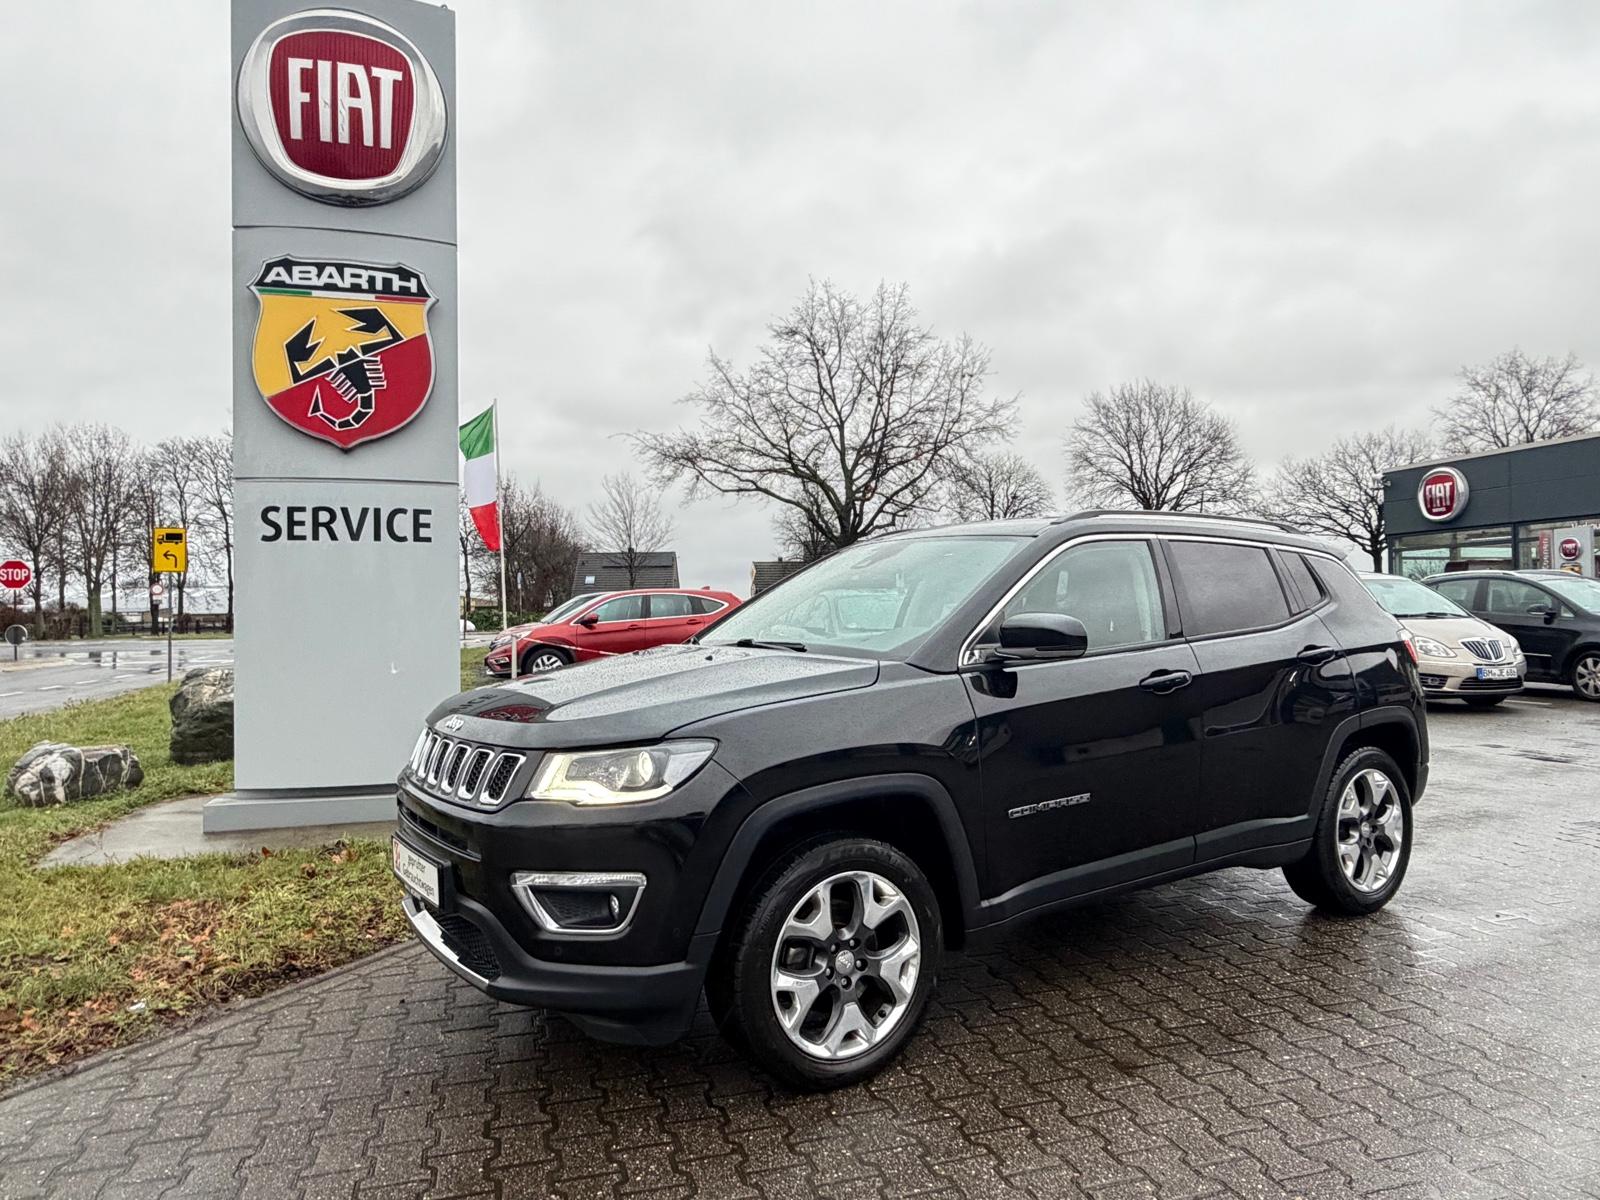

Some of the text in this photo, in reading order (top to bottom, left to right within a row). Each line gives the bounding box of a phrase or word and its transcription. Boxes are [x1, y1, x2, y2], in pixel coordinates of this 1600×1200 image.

[288, 57, 403, 149] FIAT
[264, 265, 418, 293] ABARTH
[1425, 481, 1453, 508] FIAT
[260, 505, 432, 543] SERVICE
[0, 568, 29, 581] STOP
